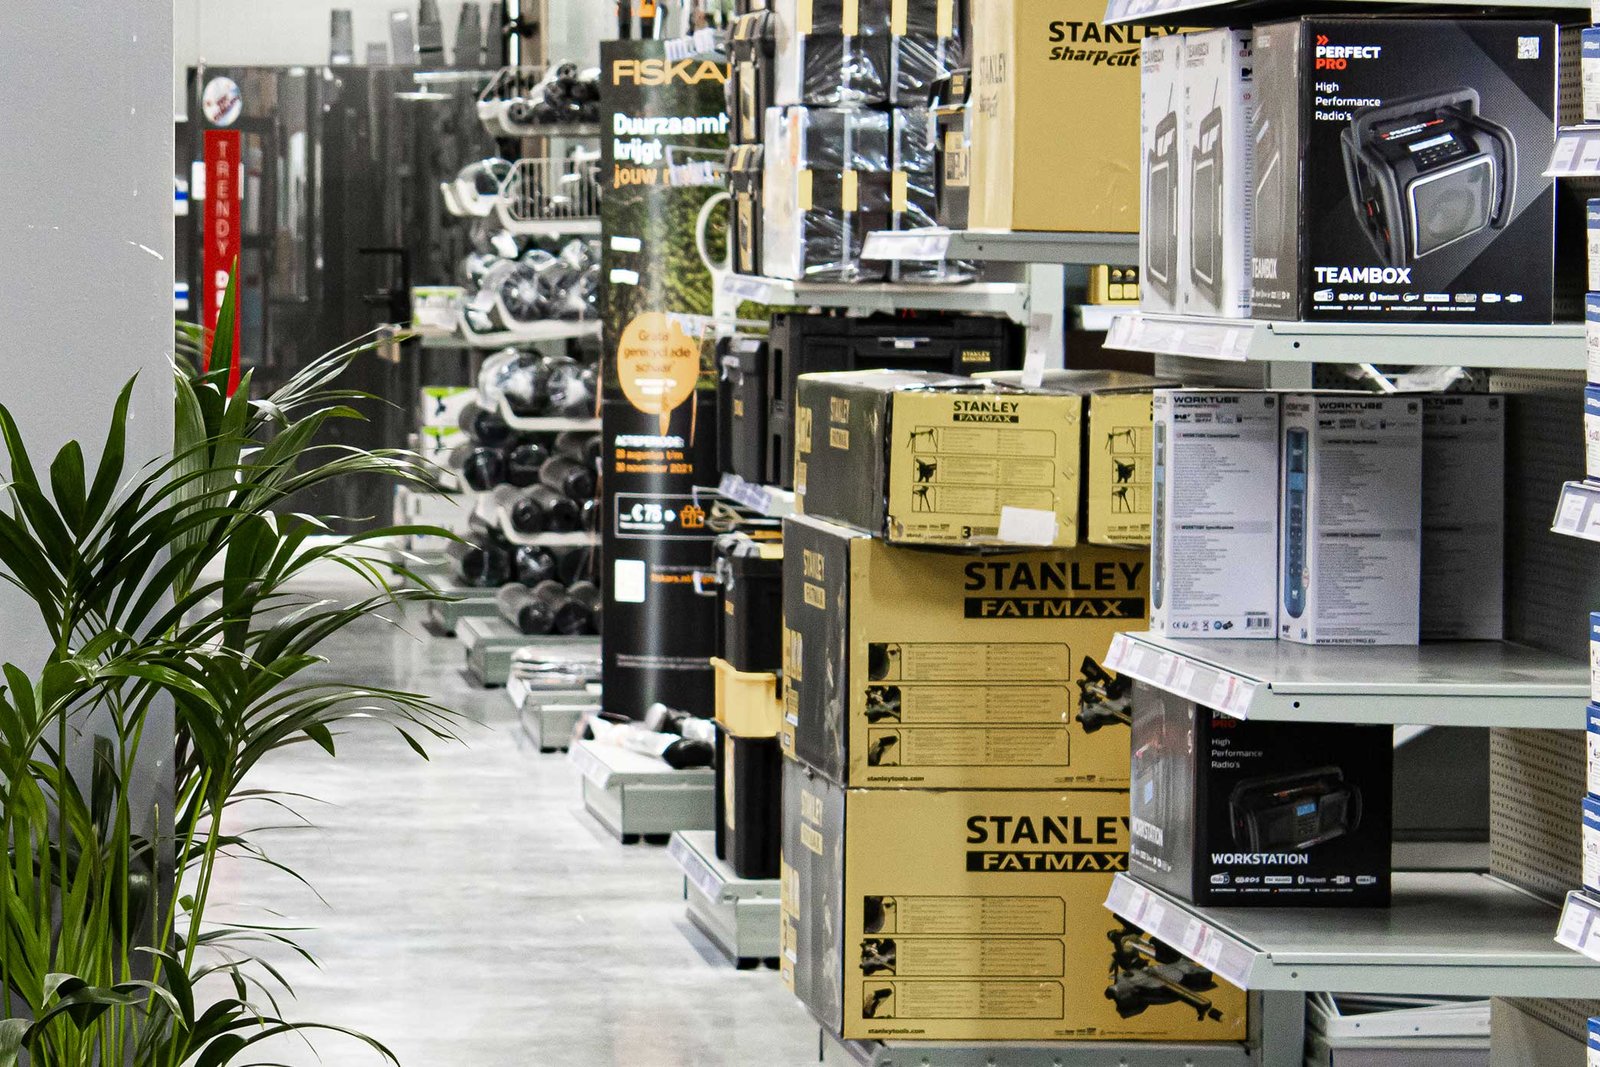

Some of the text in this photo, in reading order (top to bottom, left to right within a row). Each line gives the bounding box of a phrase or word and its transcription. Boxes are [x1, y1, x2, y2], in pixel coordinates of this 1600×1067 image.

[1049, 46, 1141, 66] Sharpcut
[1316, 47, 1381, 58] PERFECT
[1316, 59, 1347, 70] PRO
[1316, 82, 1339, 93] High
[1316, 97, 1381, 107] Performance
[1316, 111, 1352, 121] Radio's
[614, 138, 662, 165] krijgt
[613, 165, 658, 189] jouw
[215, 141, 230, 256] TRENDY
[1315, 267, 1412, 284] TEAMBOX
[953, 400, 1019, 414] STANLEY
[1318, 402, 1383, 410] WORKTUBE
[957, 415, 1013, 423] FATMAX
[962, 526, 971, 539] 3
[964, 562, 1145, 590] STANLEY
[981, 600, 1124, 616] FATMAX
[1211, 738, 1231, 747] High
[1211, 749, 1263, 758] Performance
[1211, 760, 1241, 769] Radio's
[983, 854, 1124, 871] FATMAX
[1211, 853, 1309, 865] WORKSTATION
